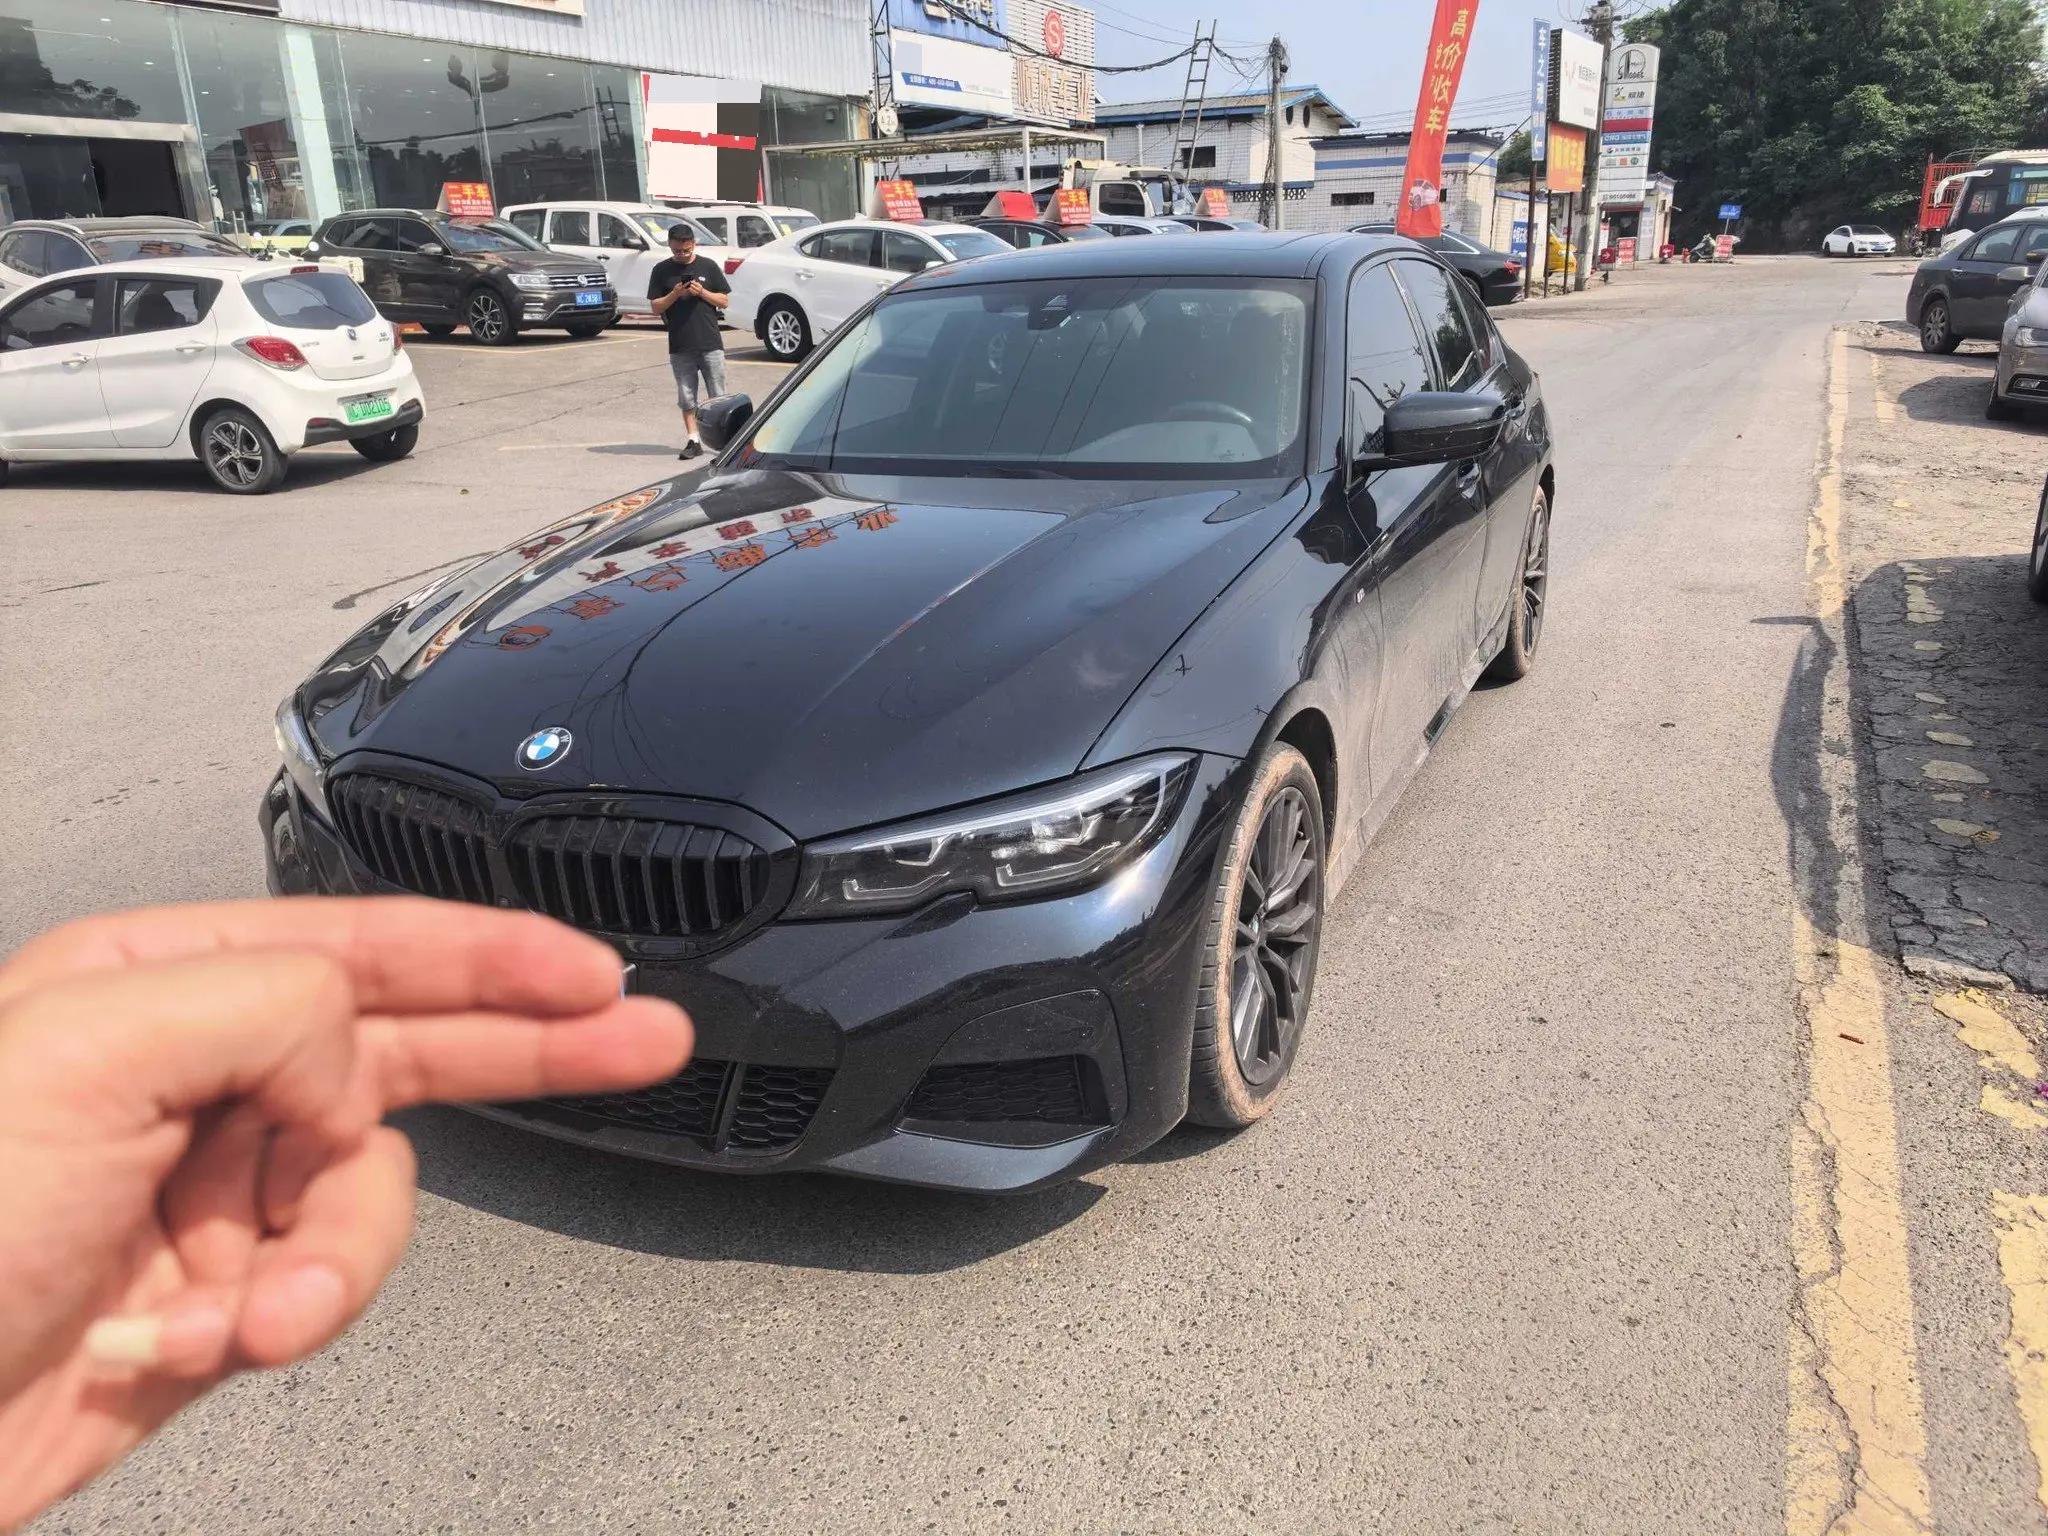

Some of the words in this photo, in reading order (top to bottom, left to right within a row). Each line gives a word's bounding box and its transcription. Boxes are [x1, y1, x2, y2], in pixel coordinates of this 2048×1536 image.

[1425, 8, 1469, 136] 高价收车
[447, 183, 489, 200] 二手车
